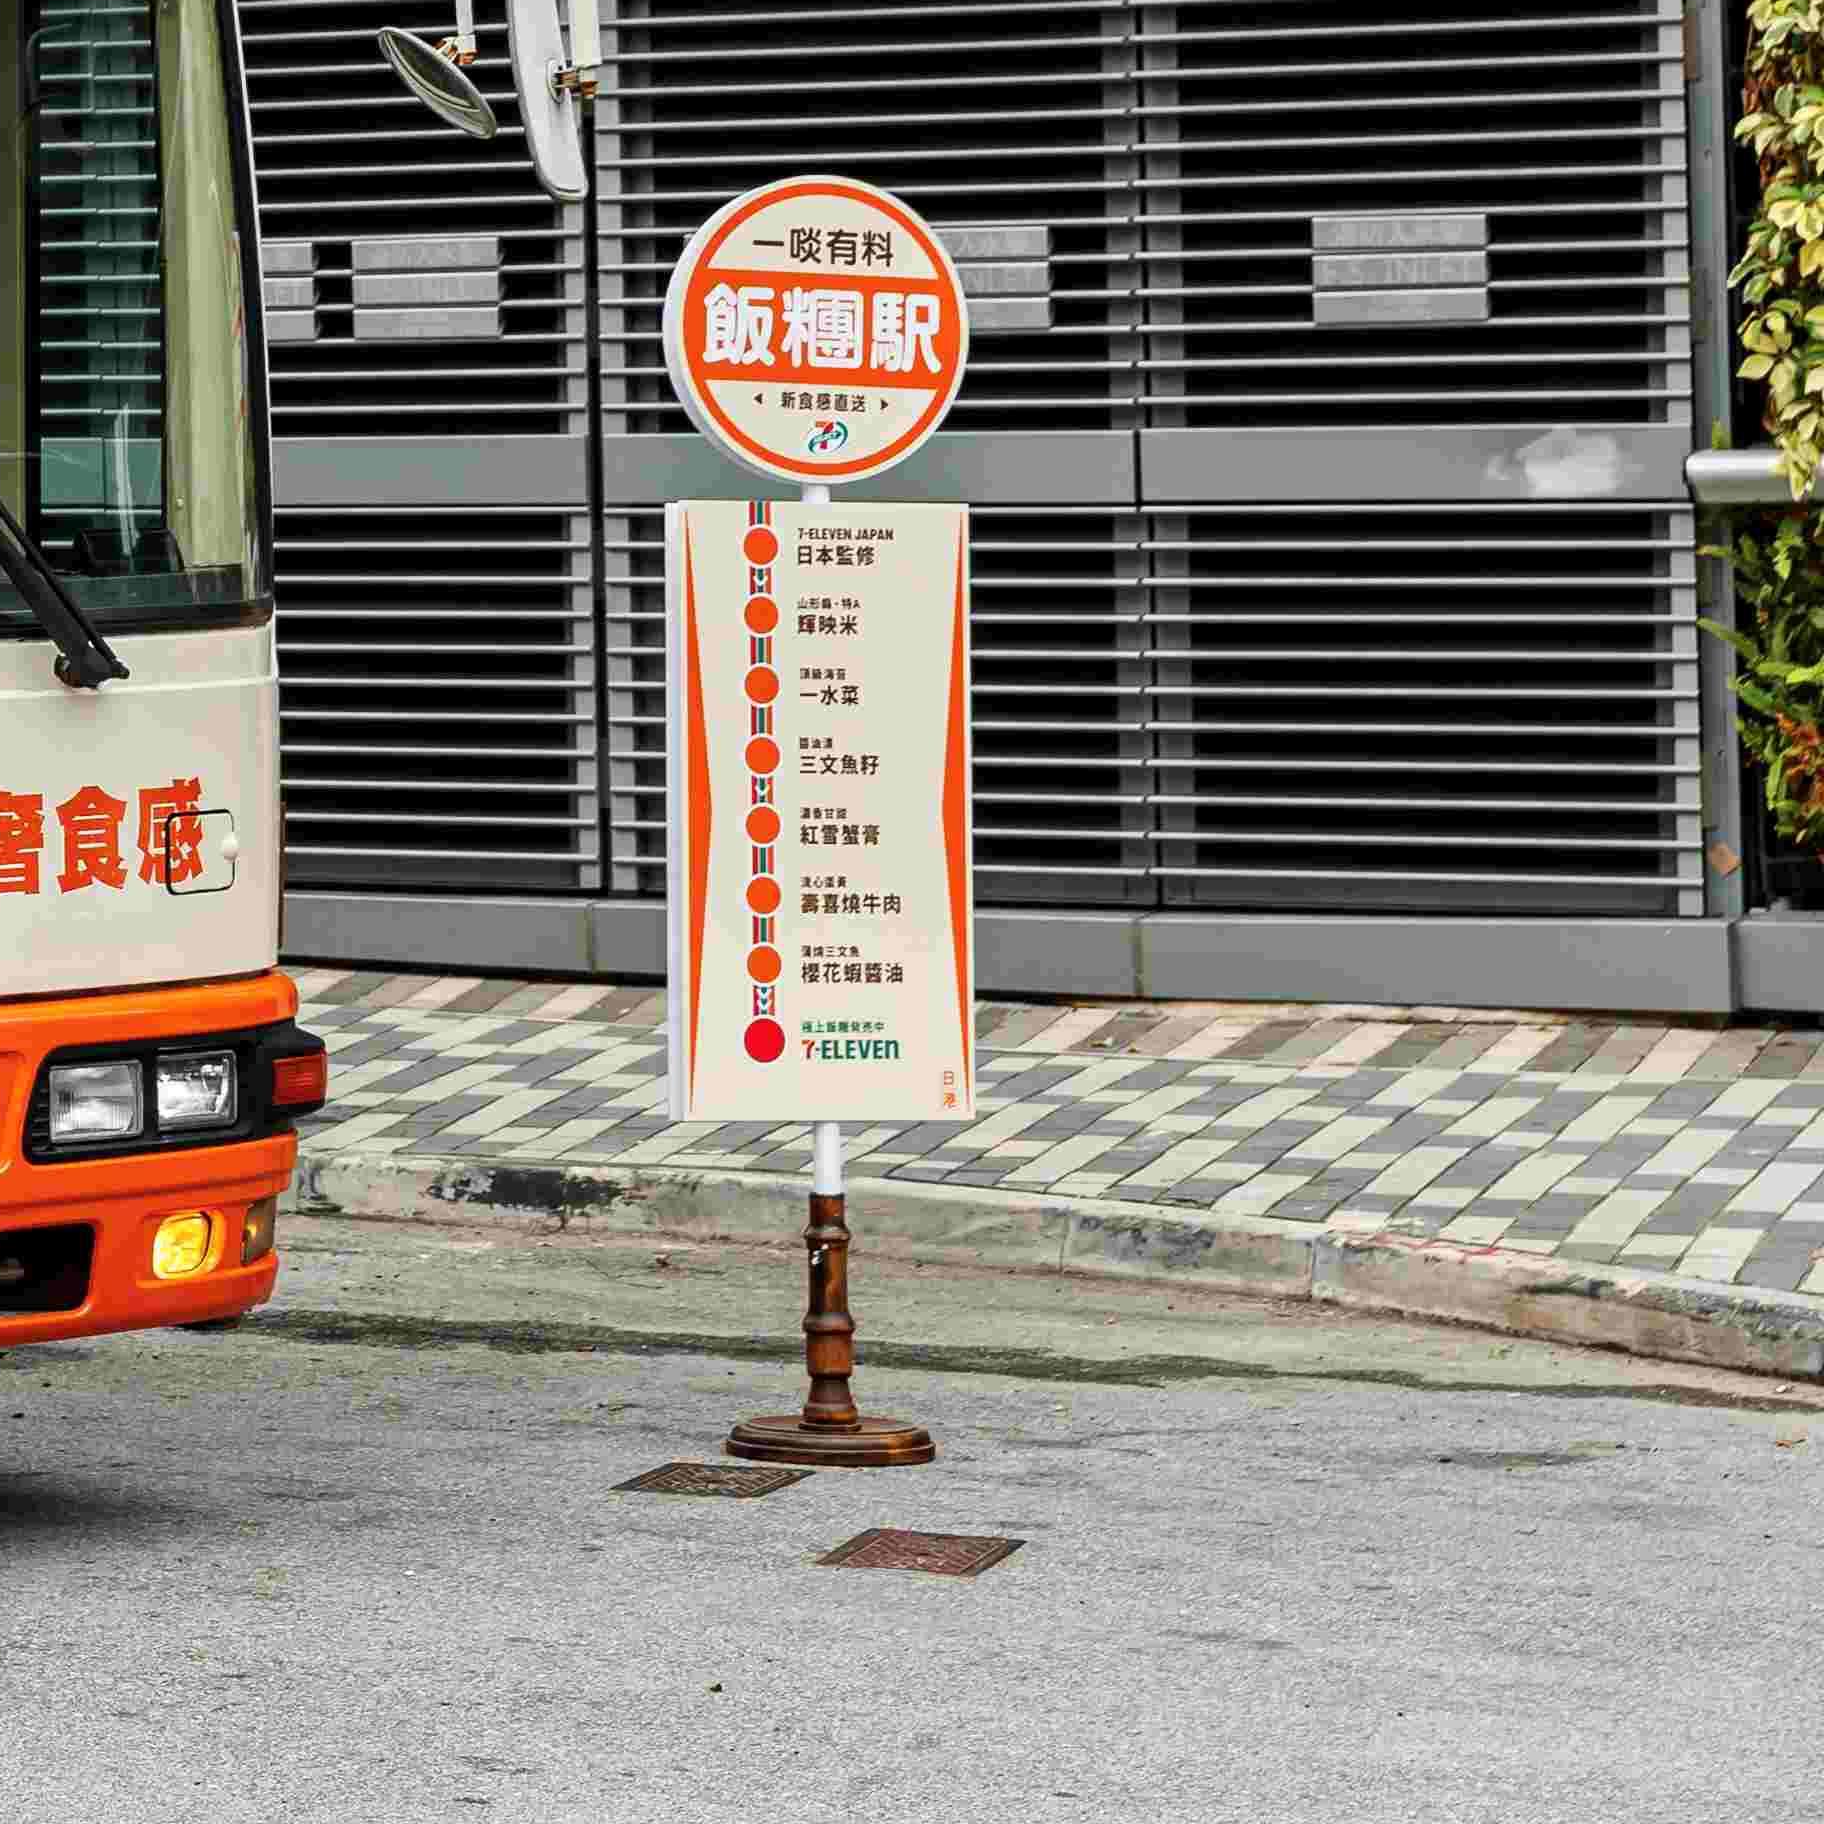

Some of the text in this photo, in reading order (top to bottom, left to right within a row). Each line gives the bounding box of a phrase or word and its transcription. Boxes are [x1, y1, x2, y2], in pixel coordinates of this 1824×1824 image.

[752, 228, 896, 268] 一啖有料
[702, 283, 943, 375] 飯糰駅
[780, 391, 868, 413] 新食感直送
[798, 528, 894, 540] 7-ELEVEN JAPAN
[798, 545, 875, 566] 日本監修
[800, 685, 860, 706] 一水菜
[800, 754, 880, 776] 三文魚籽
[801, 893, 901, 914] 壽喜燒牛肉
